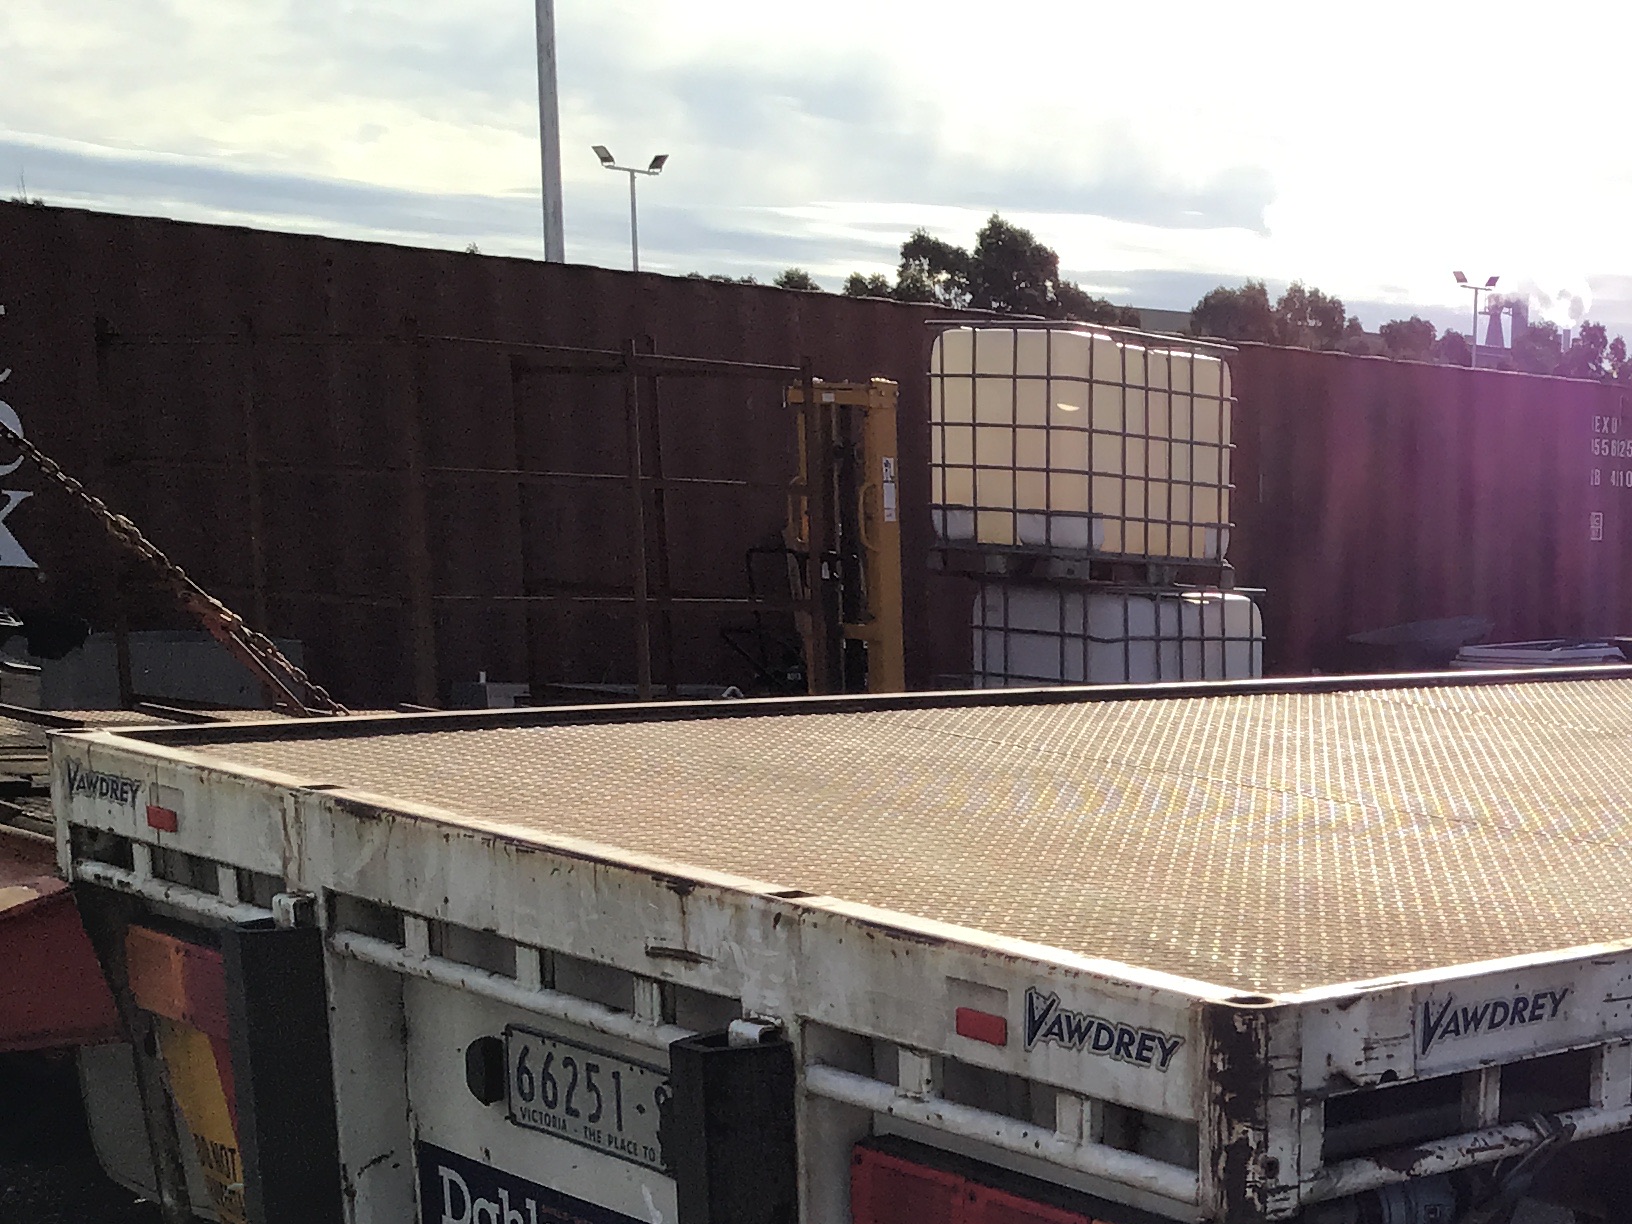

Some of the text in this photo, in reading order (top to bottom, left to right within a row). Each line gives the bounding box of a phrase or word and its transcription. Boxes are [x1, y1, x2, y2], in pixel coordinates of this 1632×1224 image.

[1592, 415, 1619, 434] EXU
[66, 757, 141, 809] VAWDREY
[1026, 989, 1183, 1069] VAWDREY
[1421, 987, 1569, 1056] VAWDREY
[516, 1044, 624, 1132] 66251
[519, 1106, 568, 1133] VICTORIA
[582, 1125, 602, 1144] THE
[607, 1133, 639, 1157] PLACE
[642, 1145, 656, 1163] TO
